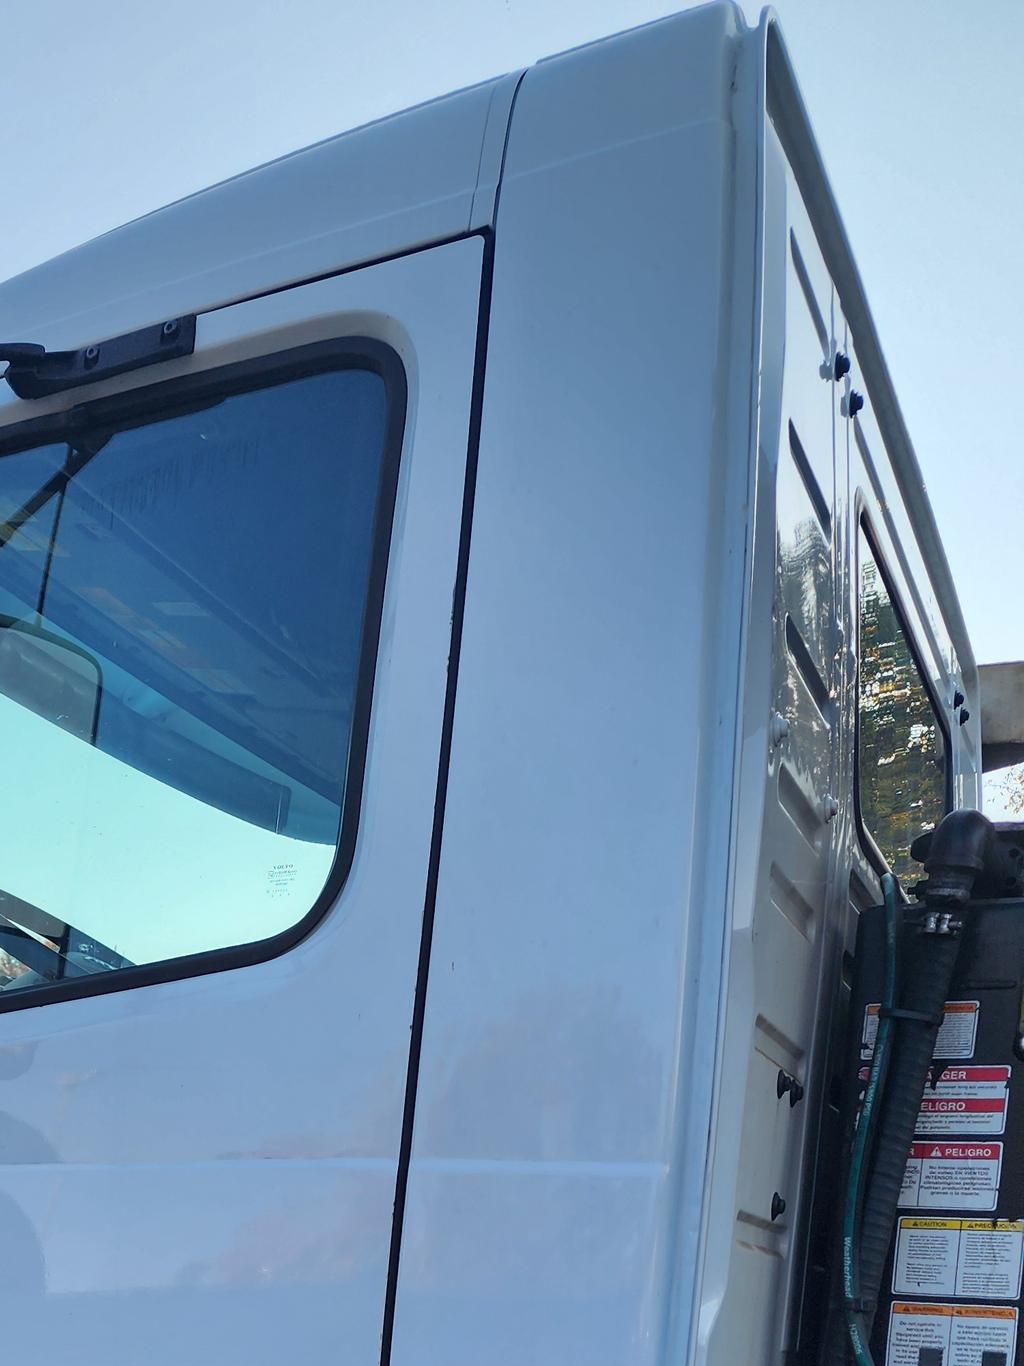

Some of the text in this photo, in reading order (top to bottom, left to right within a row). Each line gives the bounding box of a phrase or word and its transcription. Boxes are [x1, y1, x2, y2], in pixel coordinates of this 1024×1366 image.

[920, 1102, 966, 1111] ELIGRO
[945, 1148, 991, 1157] PELIGRO
[843, 1237, 853, 1298] Weatherhead
